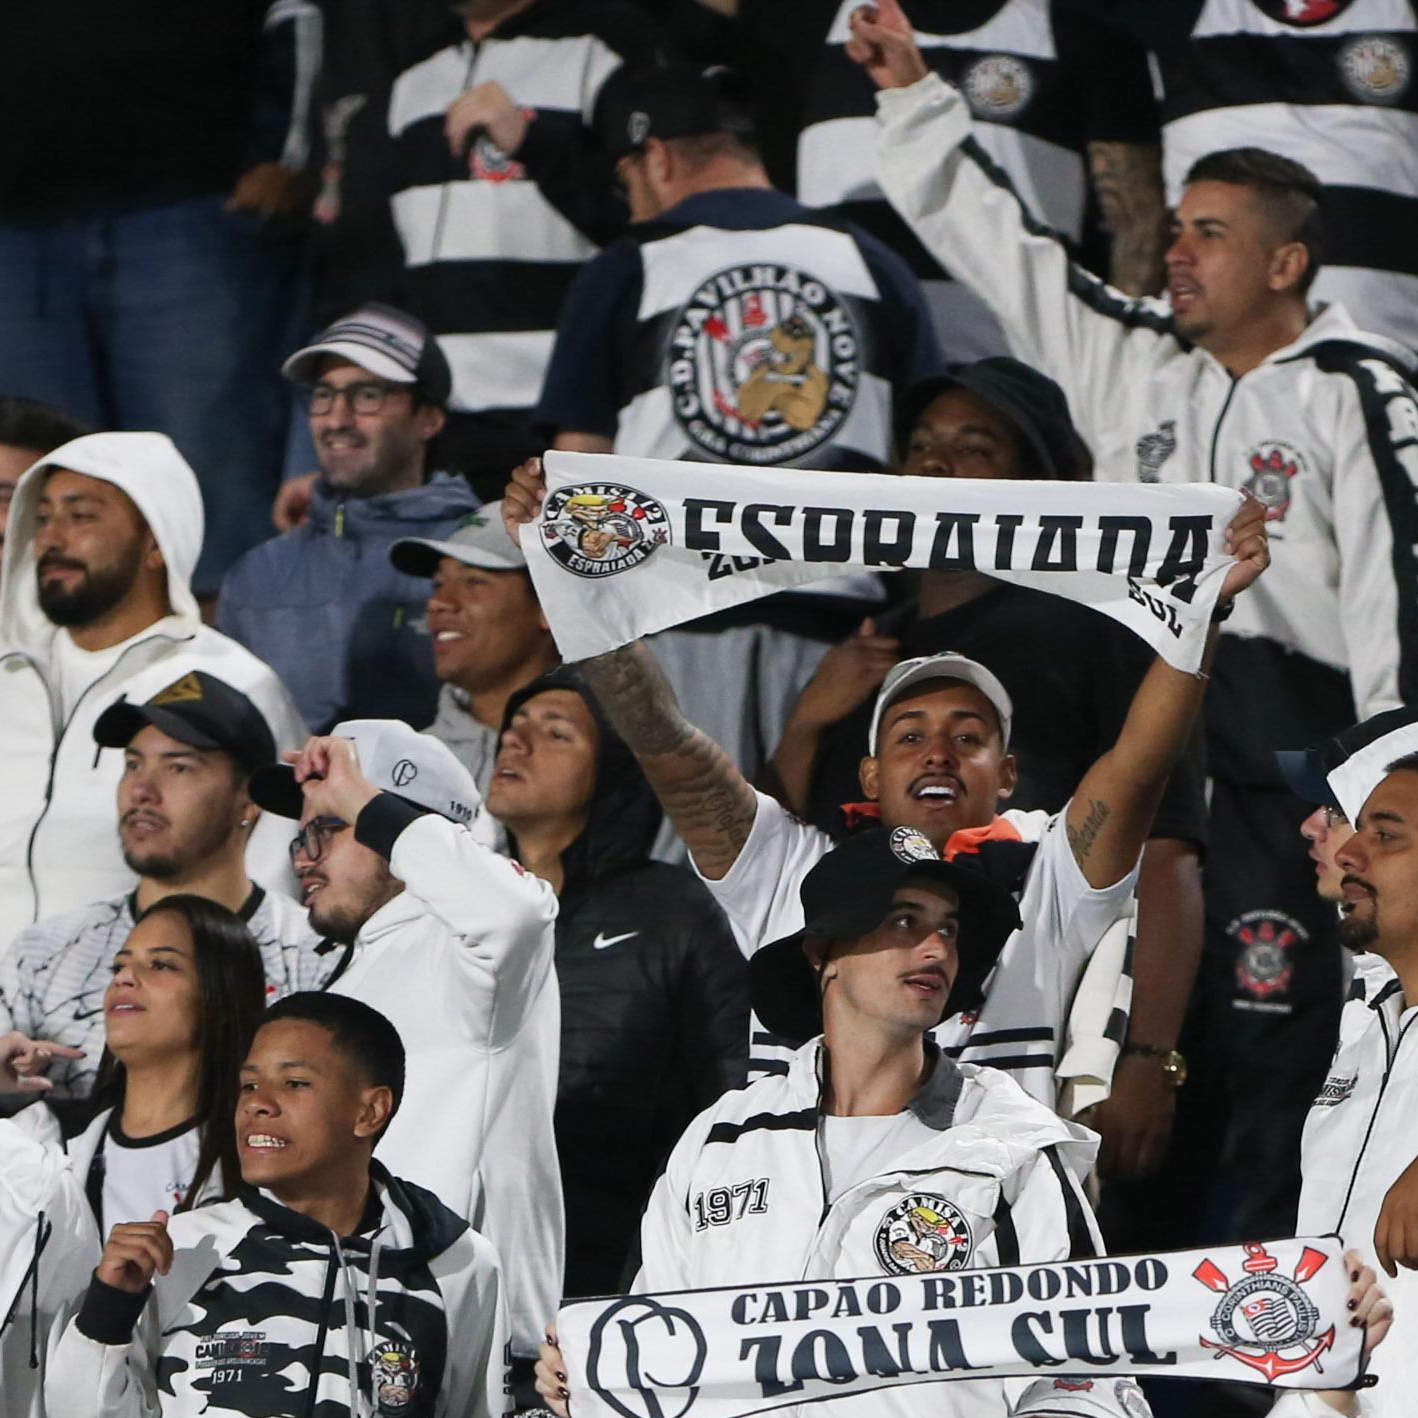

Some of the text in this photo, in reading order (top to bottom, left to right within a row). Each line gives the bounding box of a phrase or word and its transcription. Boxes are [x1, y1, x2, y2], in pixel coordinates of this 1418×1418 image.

[567, 548, 645, 574] ESPRAIADA
[694, 1178, 770, 1232] 1971
[896, 1198, 961, 1228] CAMISA
[921, 1258, 1169, 1311] REDONDO
[1221, 1281, 1290, 1322] CORINTHIANS
[1289, 1287, 1313, 1343] PAULISTA
[212, 1369, 243, 1385] 1971
[739, 1304, 1177, 1398] ZONA SUL
